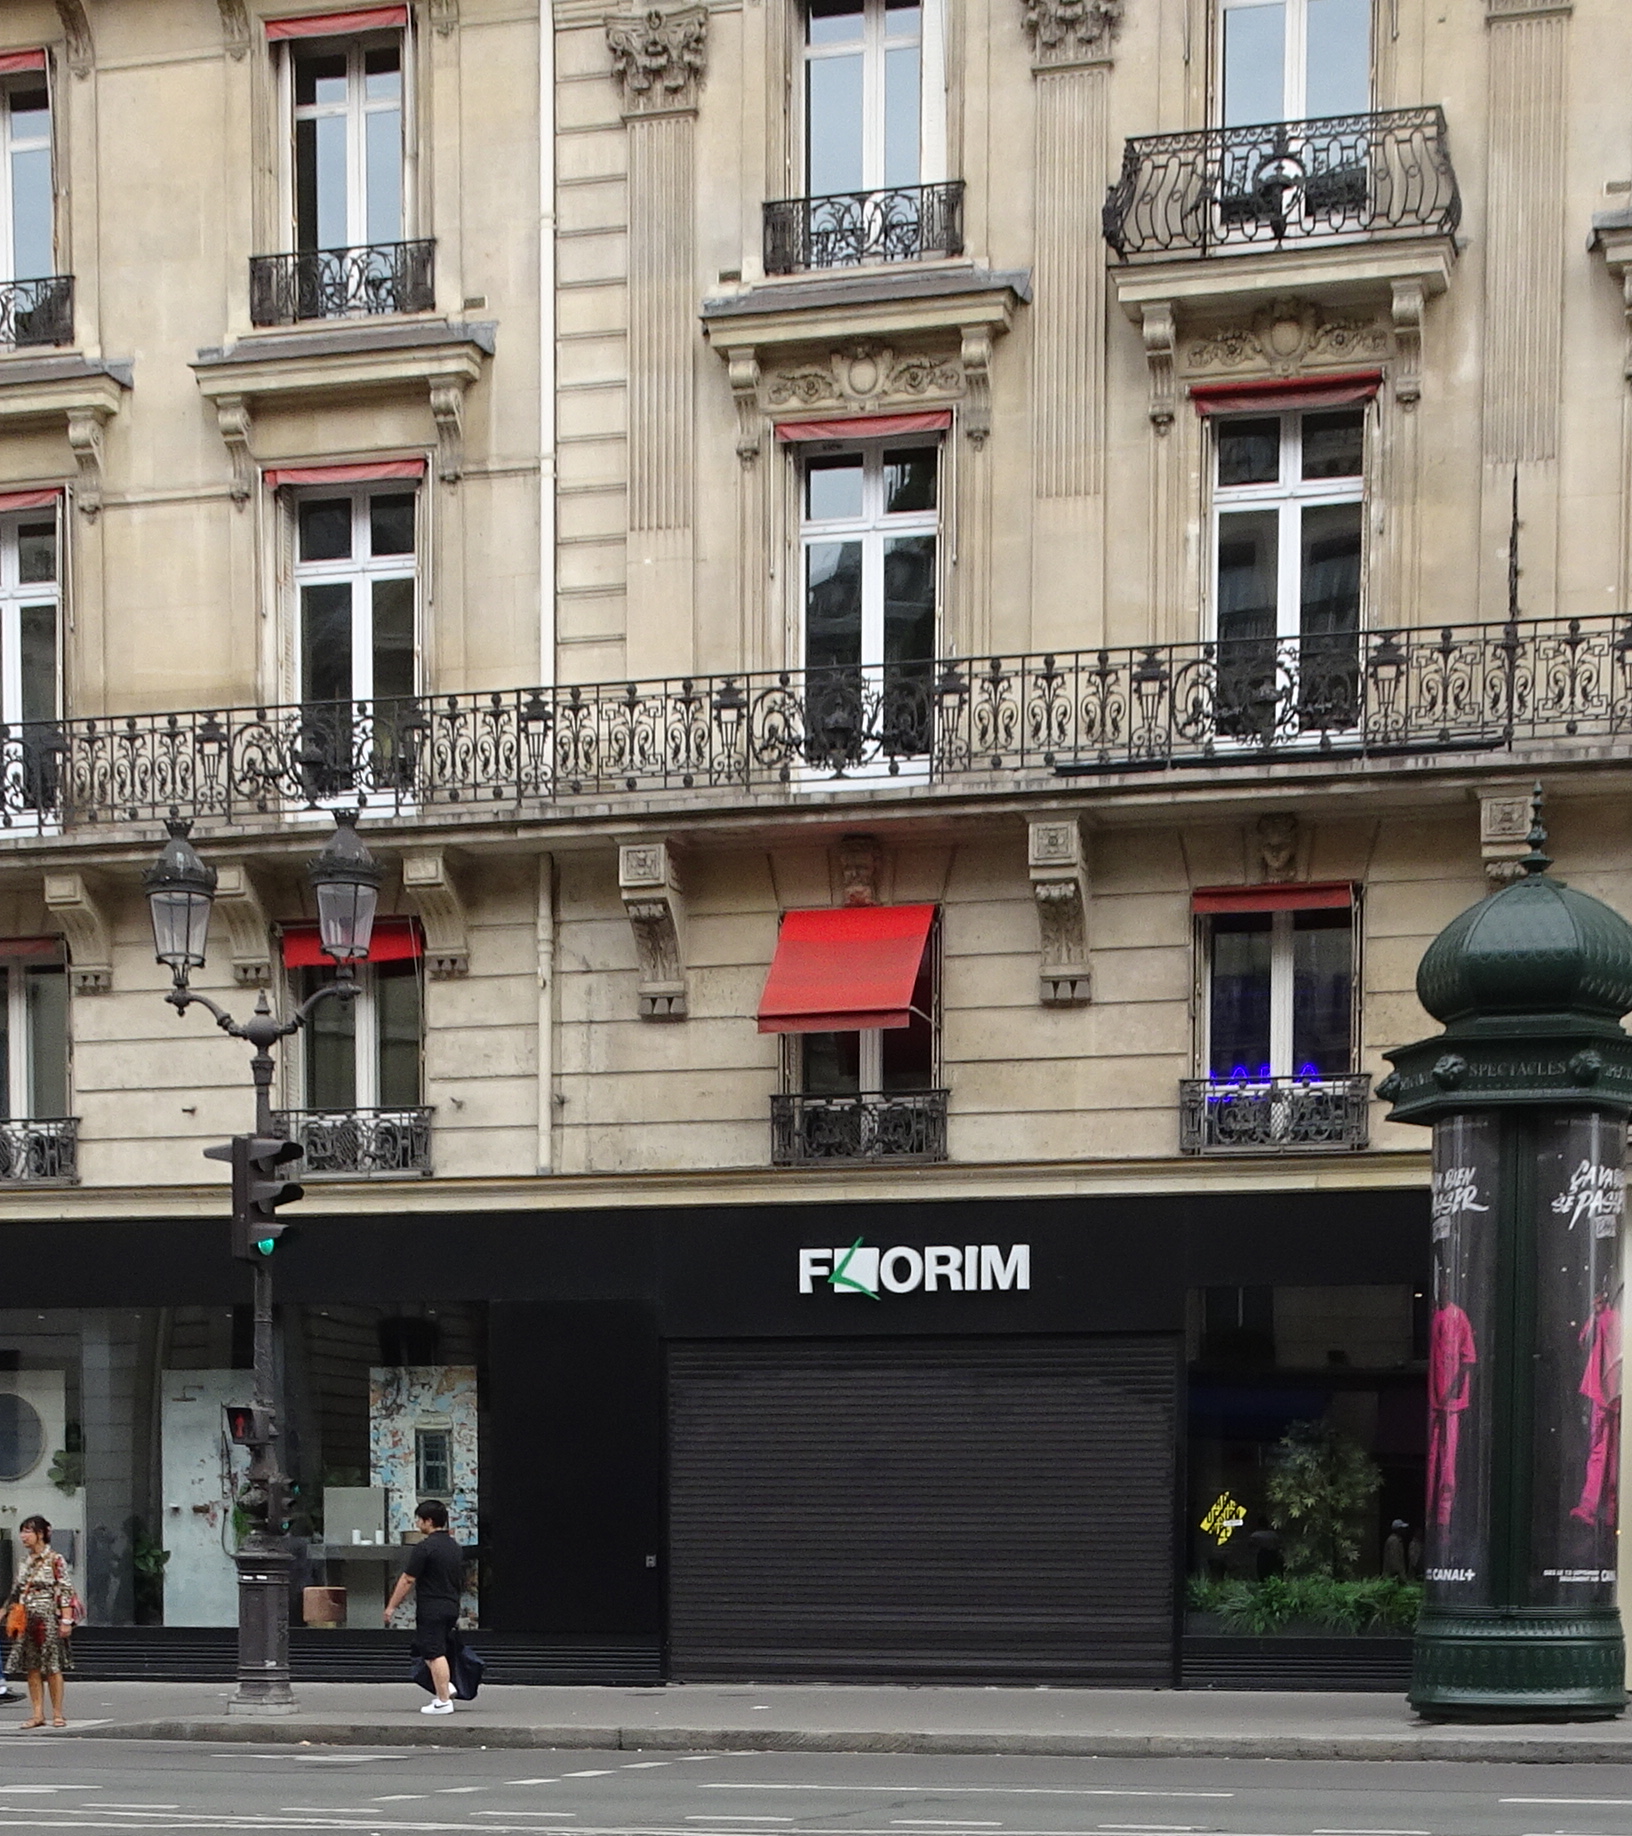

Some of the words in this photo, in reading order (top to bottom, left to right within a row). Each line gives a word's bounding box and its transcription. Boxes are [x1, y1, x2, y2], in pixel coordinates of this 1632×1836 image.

[1469, 1061, 1567, 1079] SPECTACLES
[1568, 1190, 1626, 1230] PASS
[799, 1236, 1030, 1301] FLORIM
[1433, 1569, 1476, 1582] CANAL+
